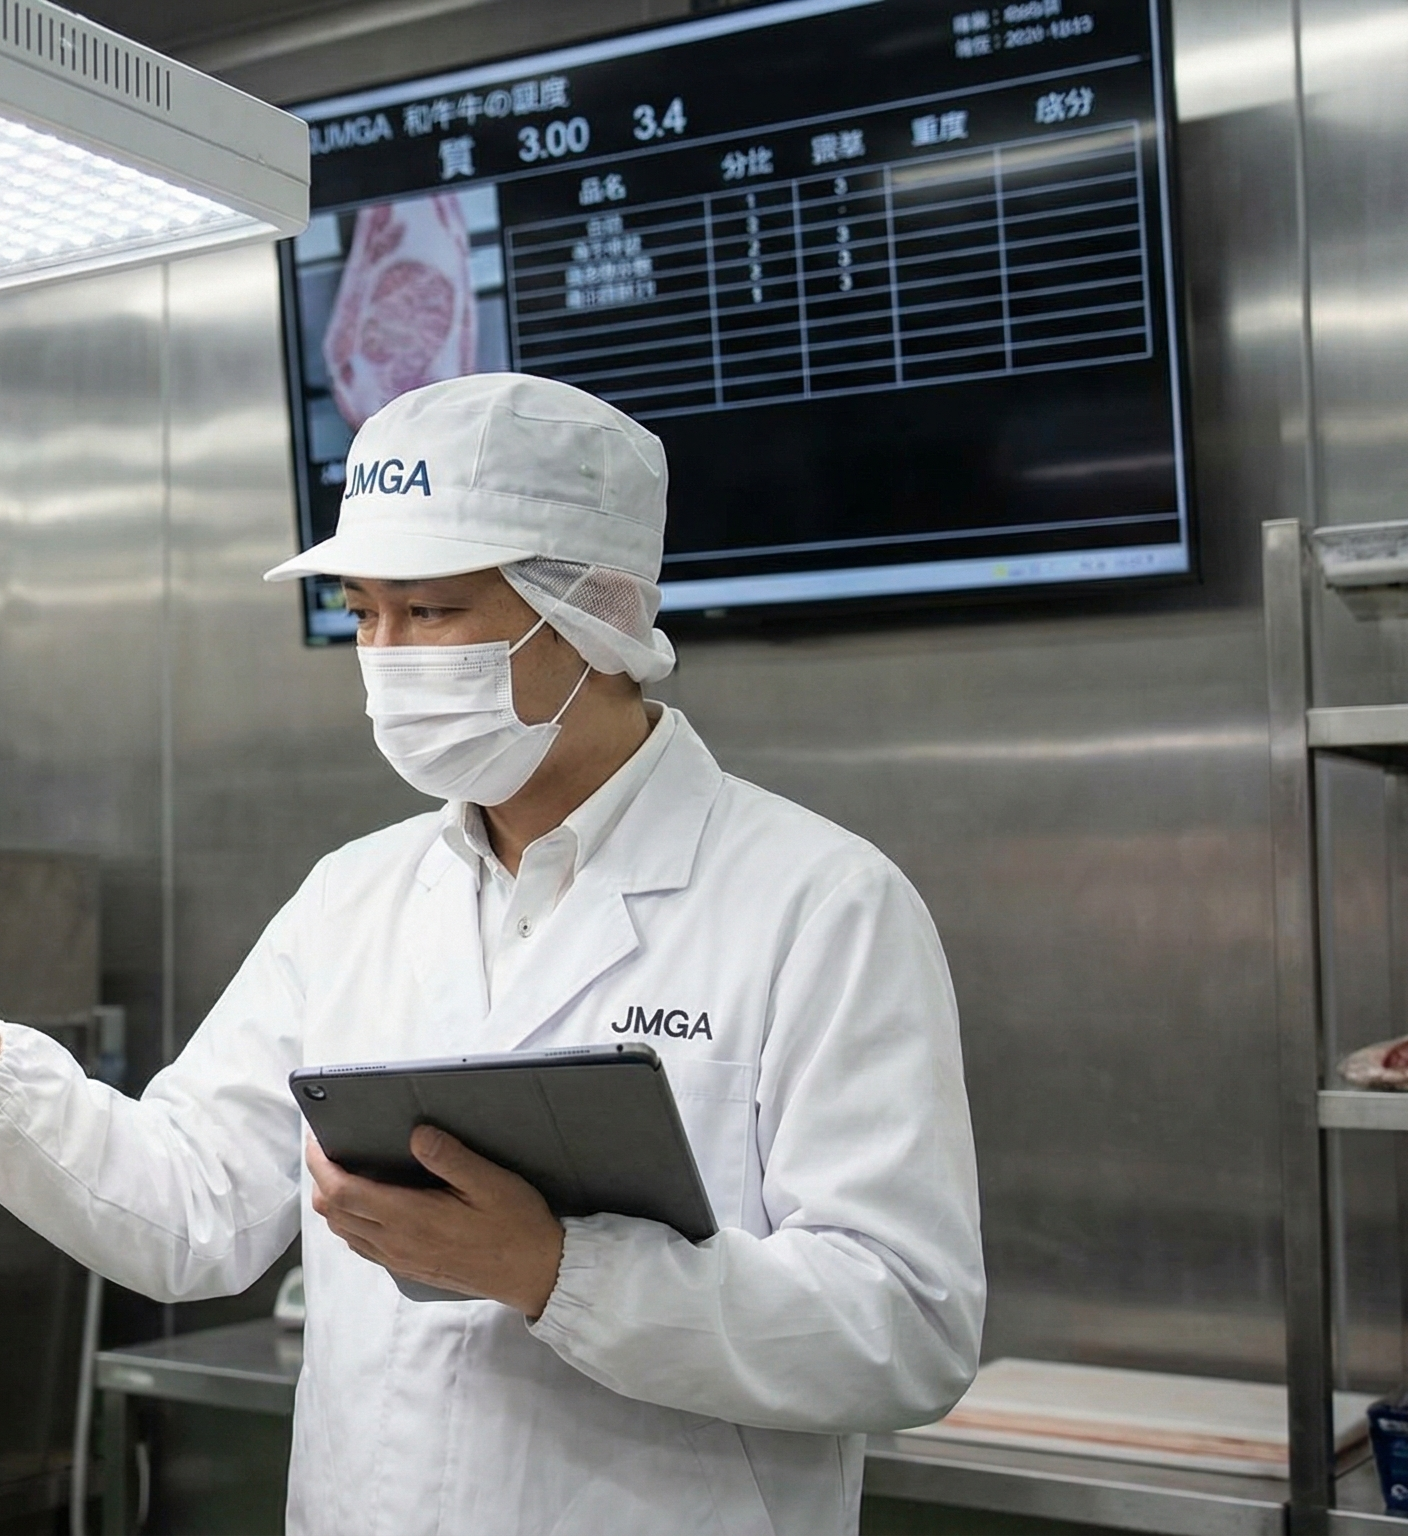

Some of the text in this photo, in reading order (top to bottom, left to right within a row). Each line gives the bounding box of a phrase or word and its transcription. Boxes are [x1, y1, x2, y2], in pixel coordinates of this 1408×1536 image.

[517, 116, 590, 163] 3.00
[632, 96, 688, 141] 3.4
[345, 459, 431, 499] JMGA
[611, 1006, 713, 1040] JMGA
